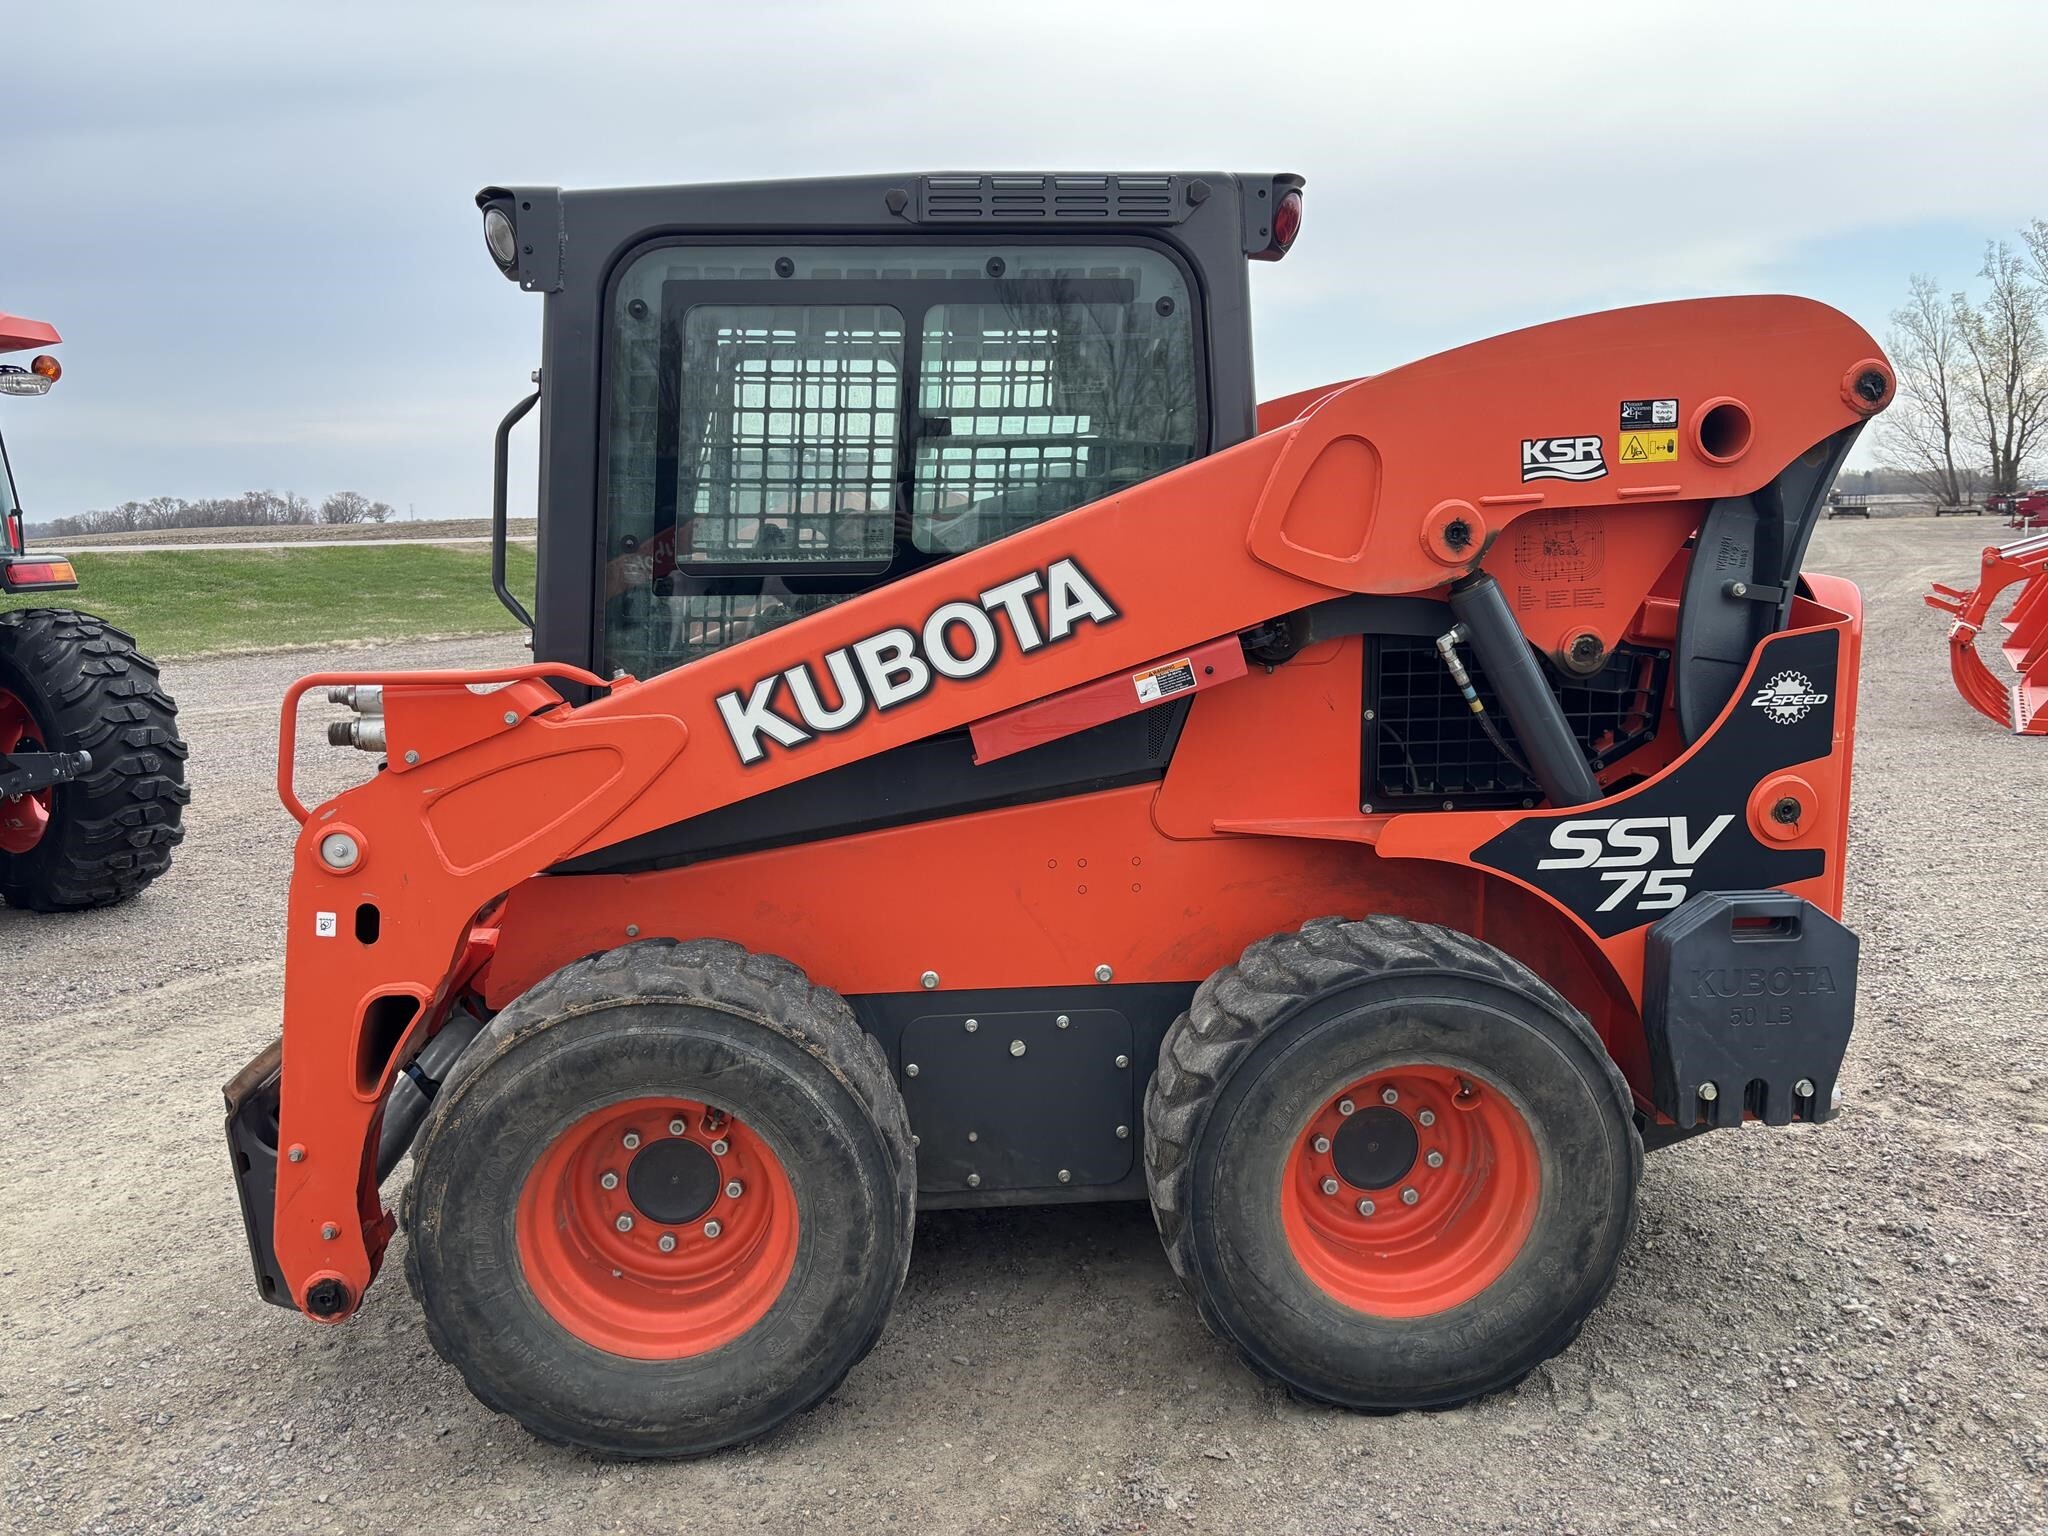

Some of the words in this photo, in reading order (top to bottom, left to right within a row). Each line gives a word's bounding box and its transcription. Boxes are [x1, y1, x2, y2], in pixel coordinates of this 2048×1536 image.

[1523, 438, 1601, 463] KSR
[715, 558, 1118, 764] KUBOTA
[1536, 814, 1736, 870] SSV
[1595, 868, 1694, 912] 75
[1688, 965, 1837, 1000] KUBOTA
[1728, 1006, 1757, 1027] 50
[1764, 1005, 1793, 1026] LB
